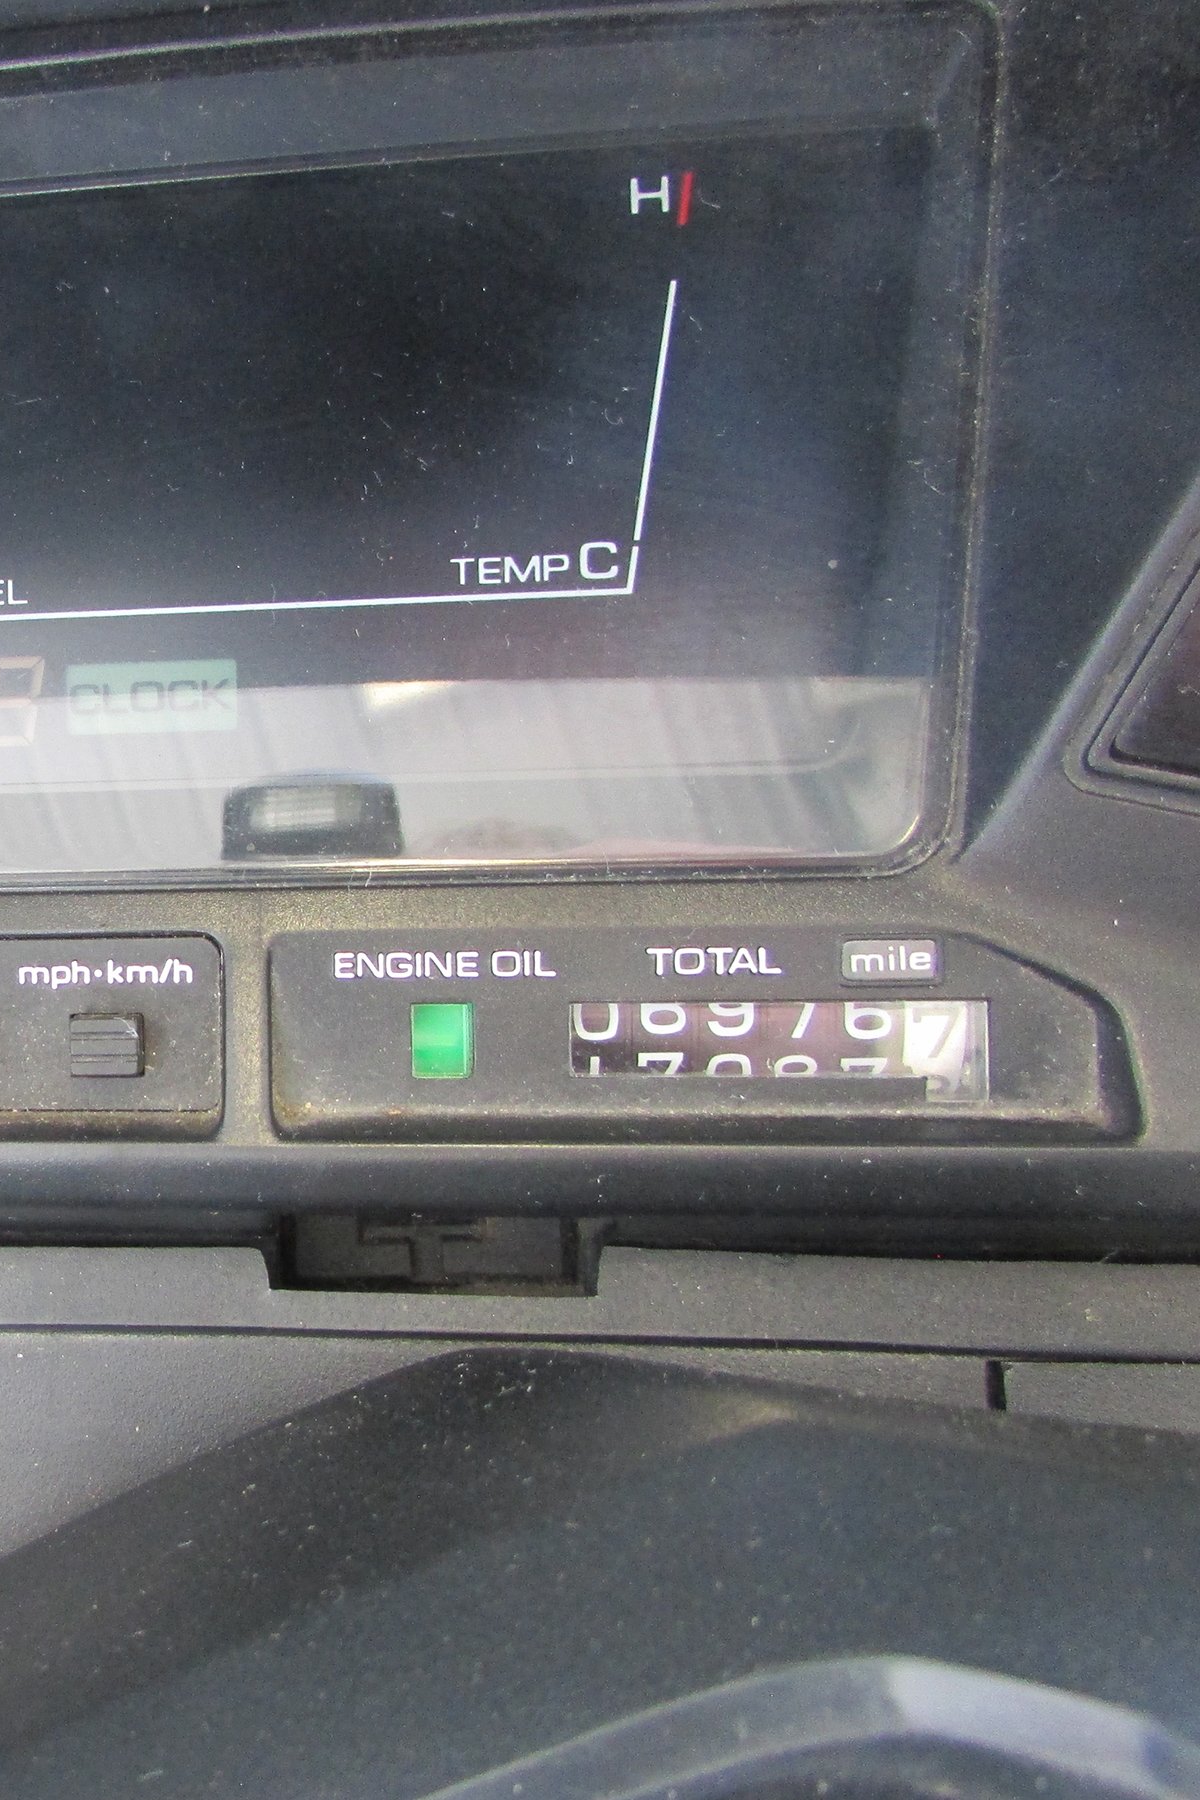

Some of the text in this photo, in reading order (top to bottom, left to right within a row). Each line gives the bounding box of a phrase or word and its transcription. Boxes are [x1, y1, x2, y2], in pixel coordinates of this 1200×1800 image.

[630, 175, 669, 214] H
[450, 541, 619, 585] TEMP C
[69, 678, 233, 718] CLOCK
[333, 950, 557, 979] ENGINE OIL
[646, 945, 782, 976] TOTAL
[849, 947, 933, 974] mile
